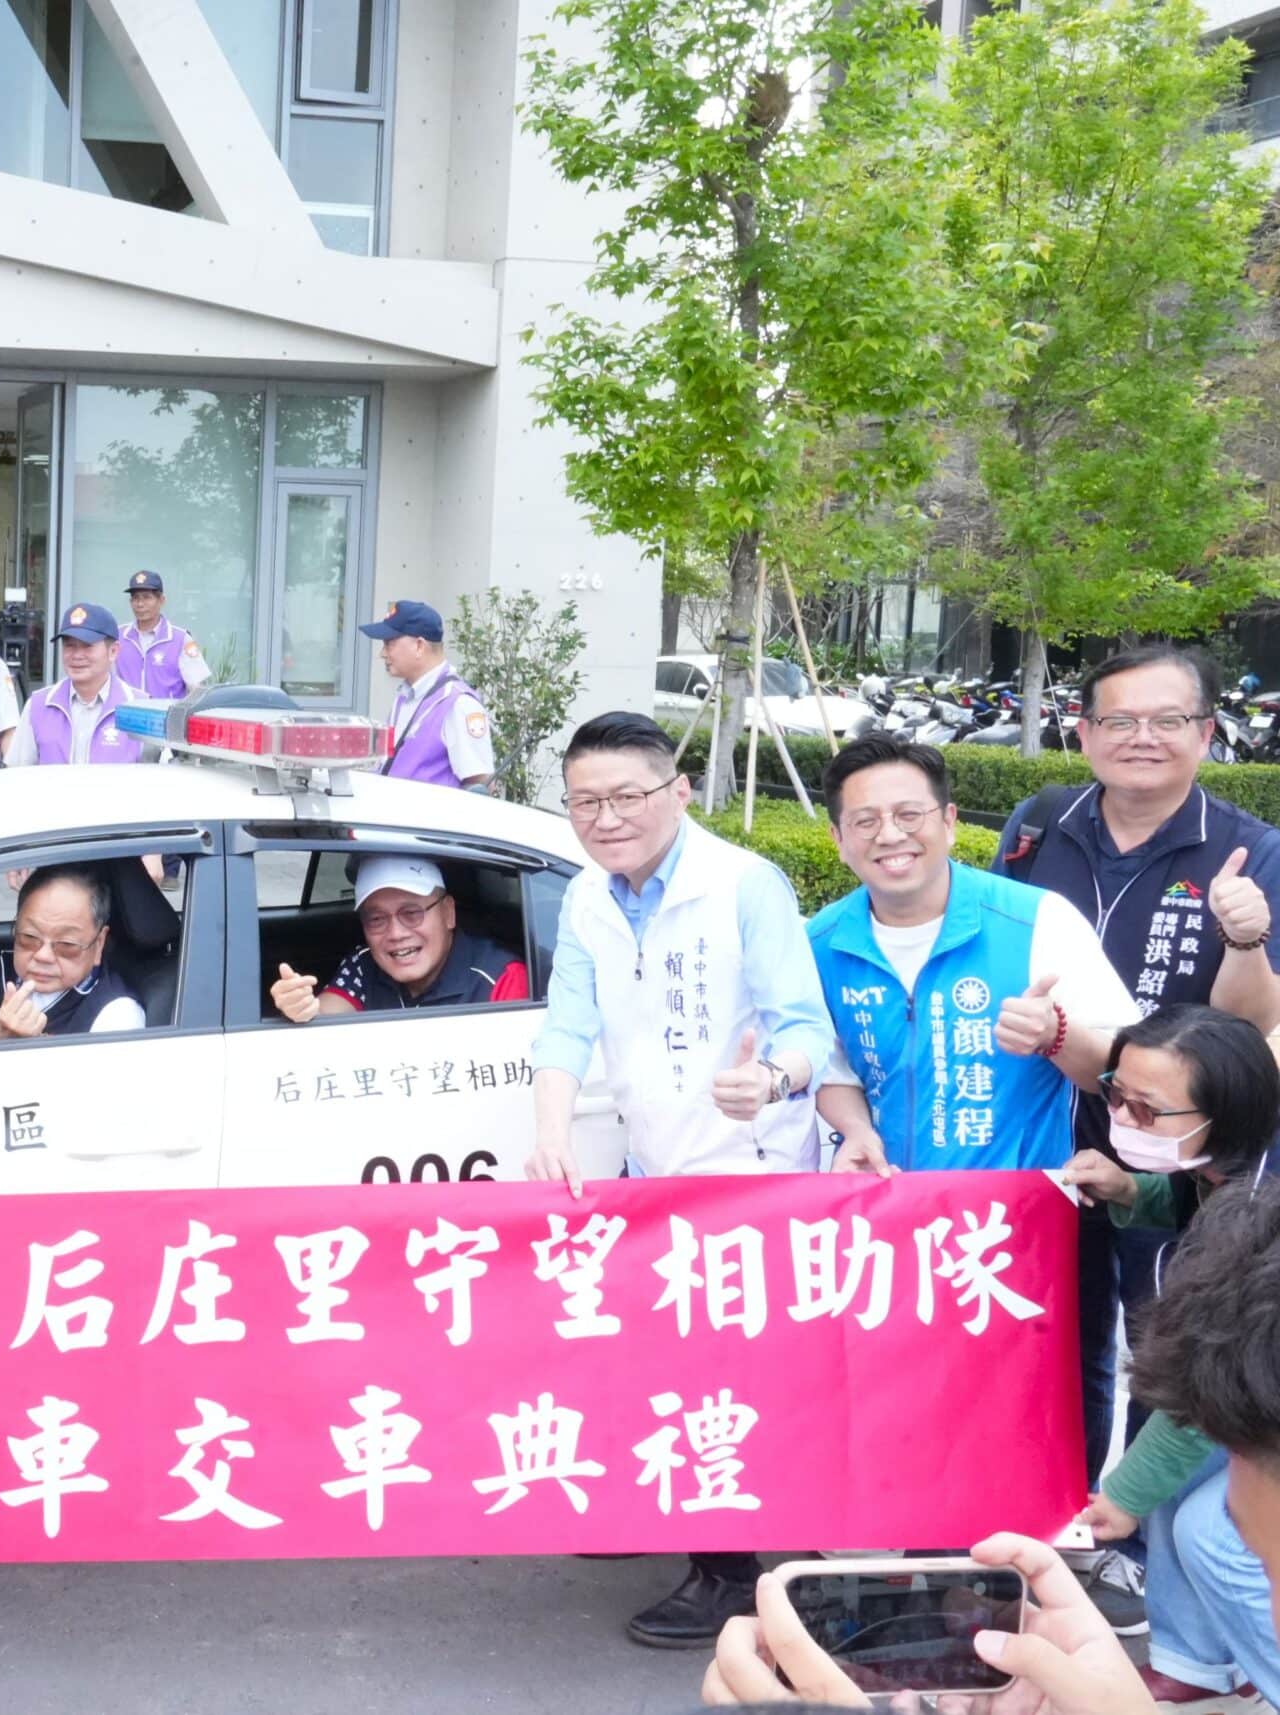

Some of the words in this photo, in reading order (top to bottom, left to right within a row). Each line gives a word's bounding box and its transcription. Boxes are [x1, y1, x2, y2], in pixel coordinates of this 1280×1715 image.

[559, 572, 604, 591] 226
[1176, 914, 1204, 976] 民政局
[663, 951, 689, 1056] 賴順仁
[273, 1057, 535, 1104] 后庄里守望相助
[952, 1015, 995, 1148] 顏建程
